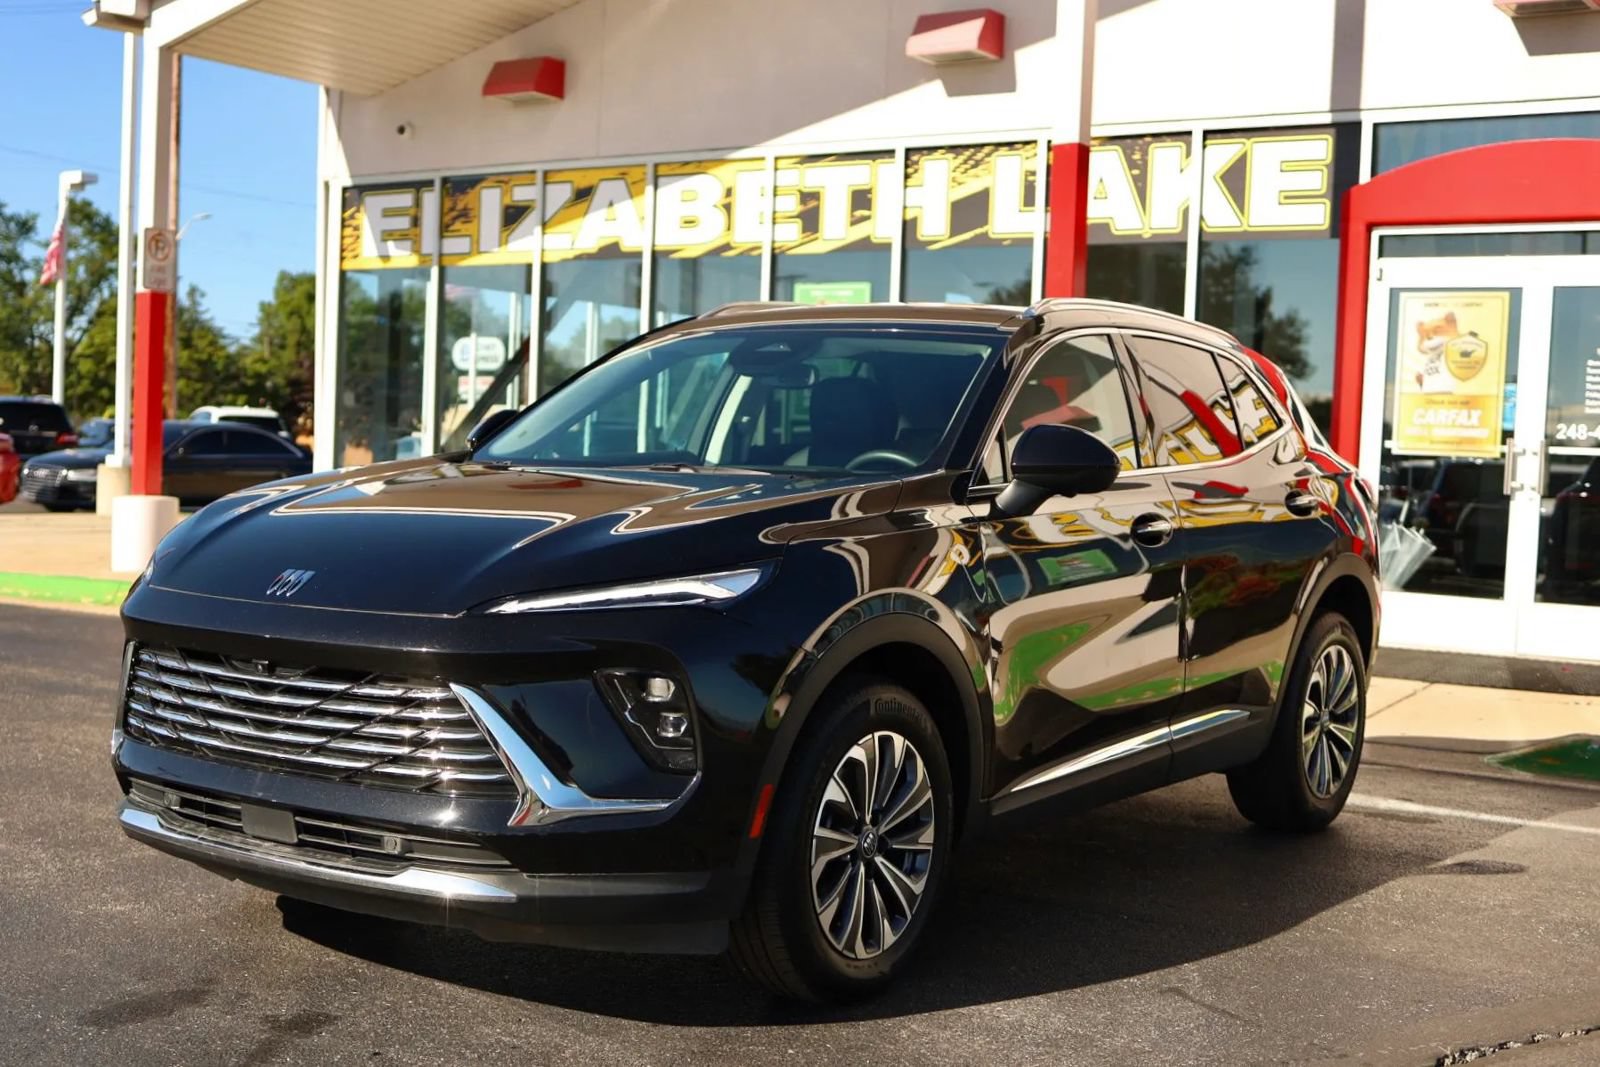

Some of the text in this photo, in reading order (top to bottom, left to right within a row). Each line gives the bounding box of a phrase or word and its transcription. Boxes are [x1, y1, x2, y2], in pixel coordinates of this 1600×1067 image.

[360, 133, 1332, 258] ELIZABETH LAKE
[1413, 407, 1482, 426] CARFAX
